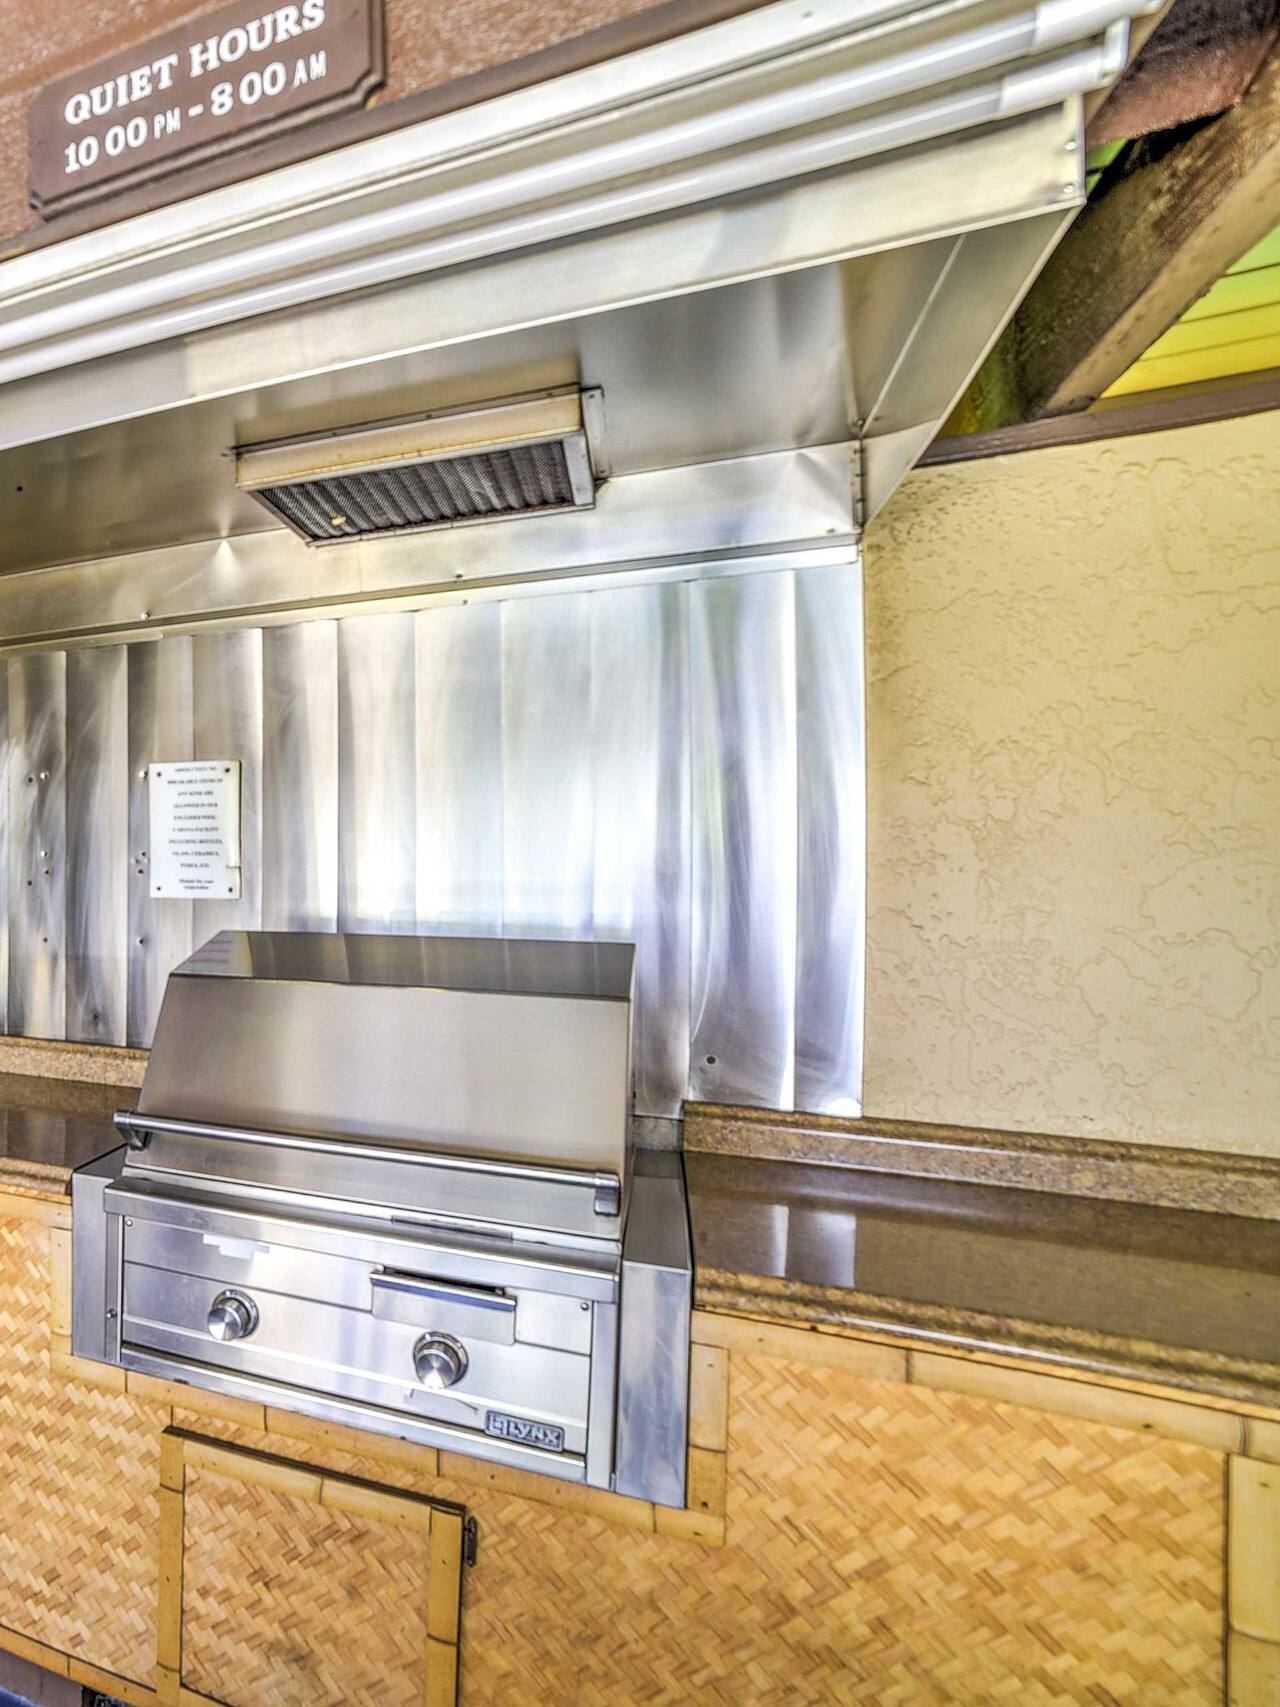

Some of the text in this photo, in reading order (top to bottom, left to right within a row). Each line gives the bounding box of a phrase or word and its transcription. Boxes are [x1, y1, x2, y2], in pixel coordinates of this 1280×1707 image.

[64, 0, 326, 126] QUIET HOURS
[153, 106, 182, 140] PM
[292, 50, 327, 90] AM
[508, 1420, 559, 1445] LYNX
